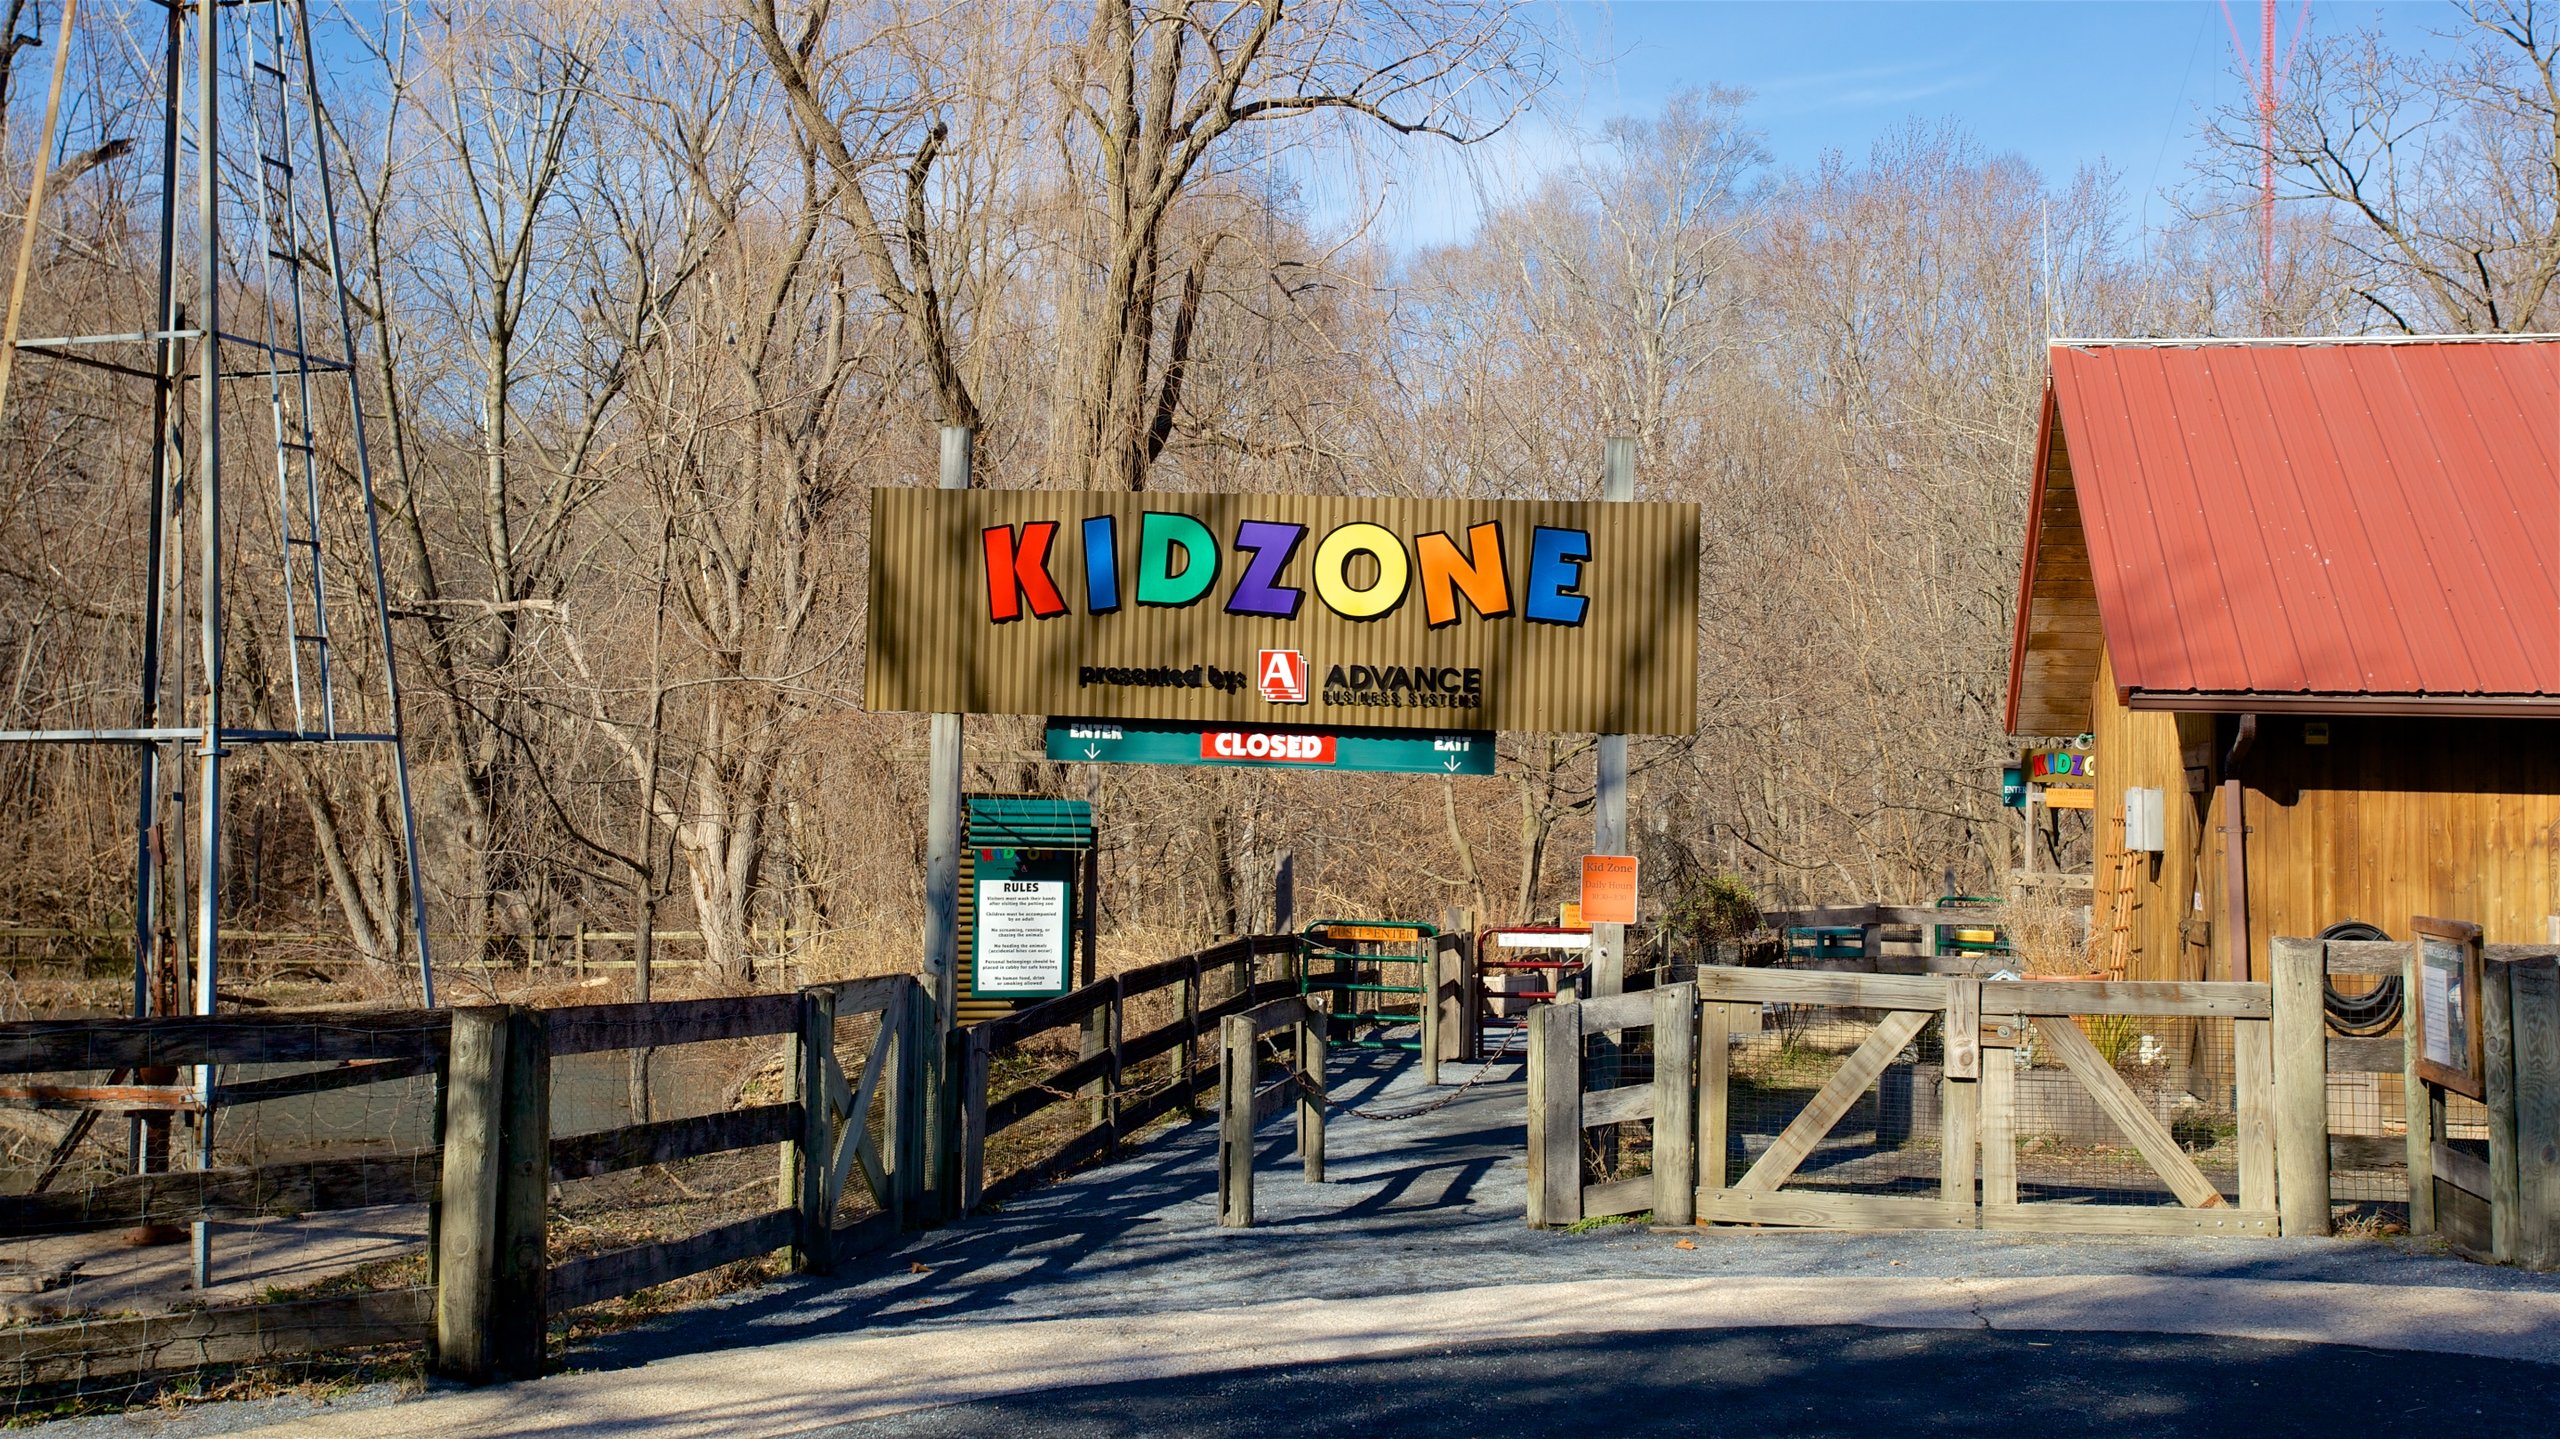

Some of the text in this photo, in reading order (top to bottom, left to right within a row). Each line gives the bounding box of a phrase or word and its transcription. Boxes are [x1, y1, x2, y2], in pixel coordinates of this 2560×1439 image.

[981, 511, 1593, 631] KIDZONE
[1079, 664, 1247, 695] presented by:
[1324, 664, 1482, 694] ADVANCE
[1322, 690, 1482, 709] BUSINESS SYSTEMS
[1069, 723, 1123, 740] ENTER
[1214, 732, 1322, 759] CLOSED
[1433, 735, 1472, 752] EXIT
[1586, 862, 1633, 873] Kid Zone
[1004, 883, 1039, 892] RULES
[1585, 881, 1633, 891] Daily Hours
[1330, 926, 1362, 938] PUSH
[1374, 928, 1414, 939] ENTER
